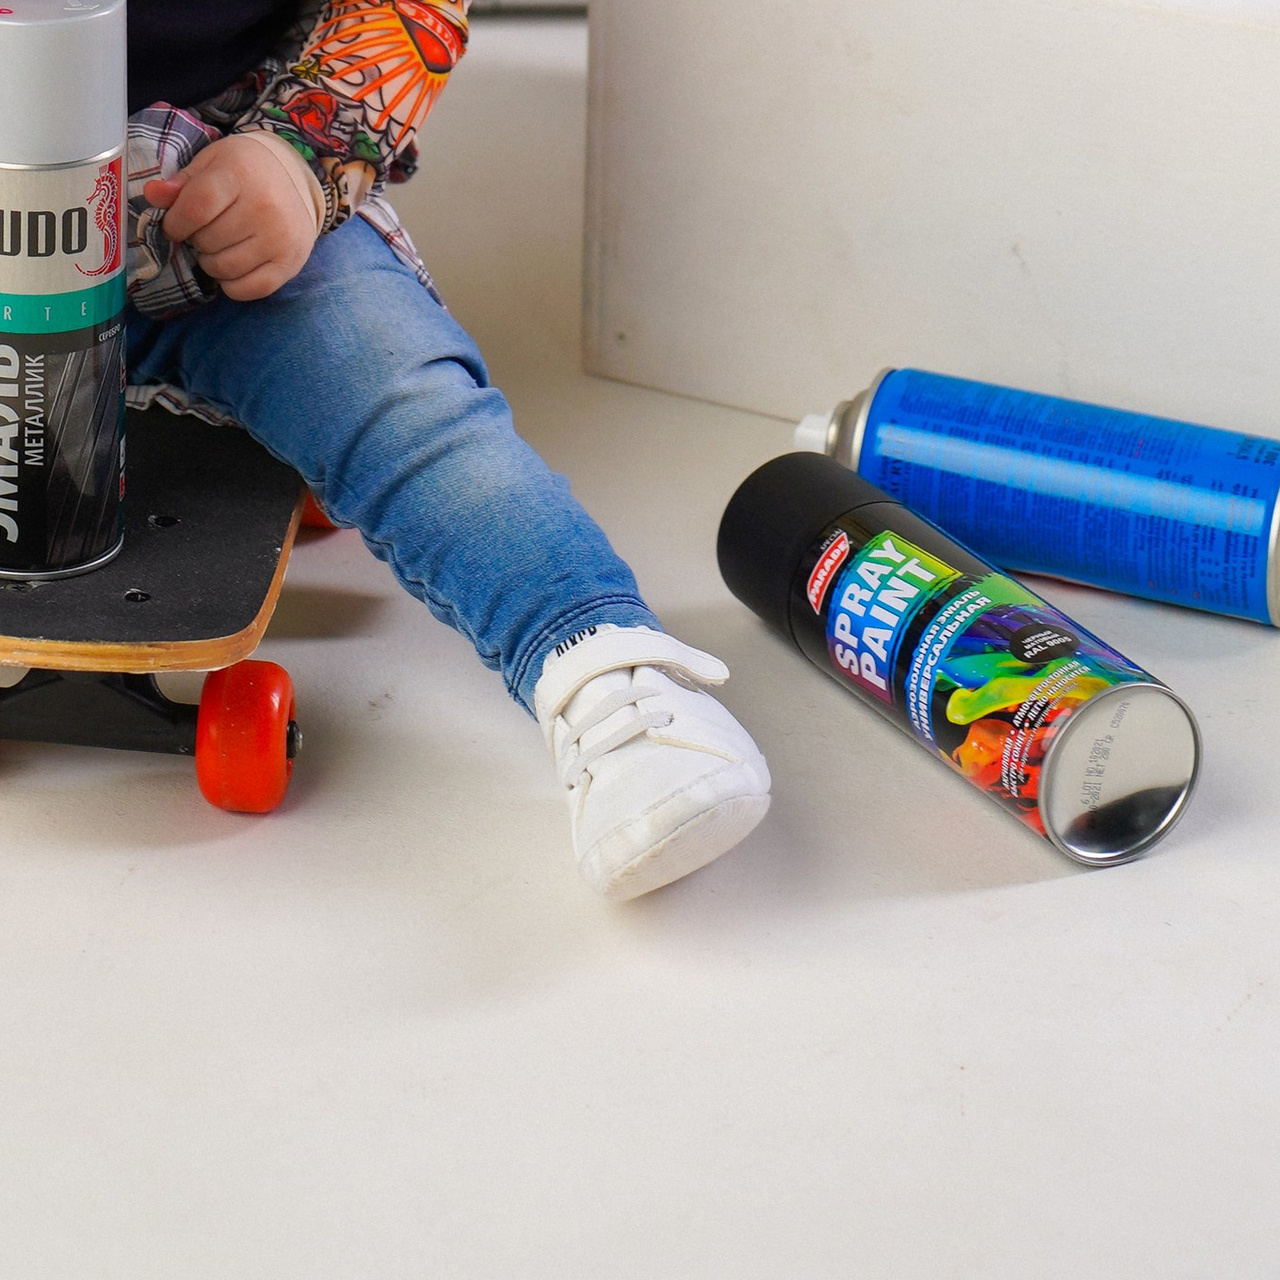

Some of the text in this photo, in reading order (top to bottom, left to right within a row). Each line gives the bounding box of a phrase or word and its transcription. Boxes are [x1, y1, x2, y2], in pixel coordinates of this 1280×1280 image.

[24, 354, 45, 466] МЕТАЛЛИК
[809, 540, 848, 604] PARADE
[834, 539, 906, 676] SPRAY
[860, 558, 937, 691] PAINT
[908, 588, 979, 728] АЭРОЗОЛЬНАЯ ЭМАЛЬ
[918, 595, 992, 740] УНИВЕРСАЛЬНАЯ
[1023, 645, 1049, 659] RAL
